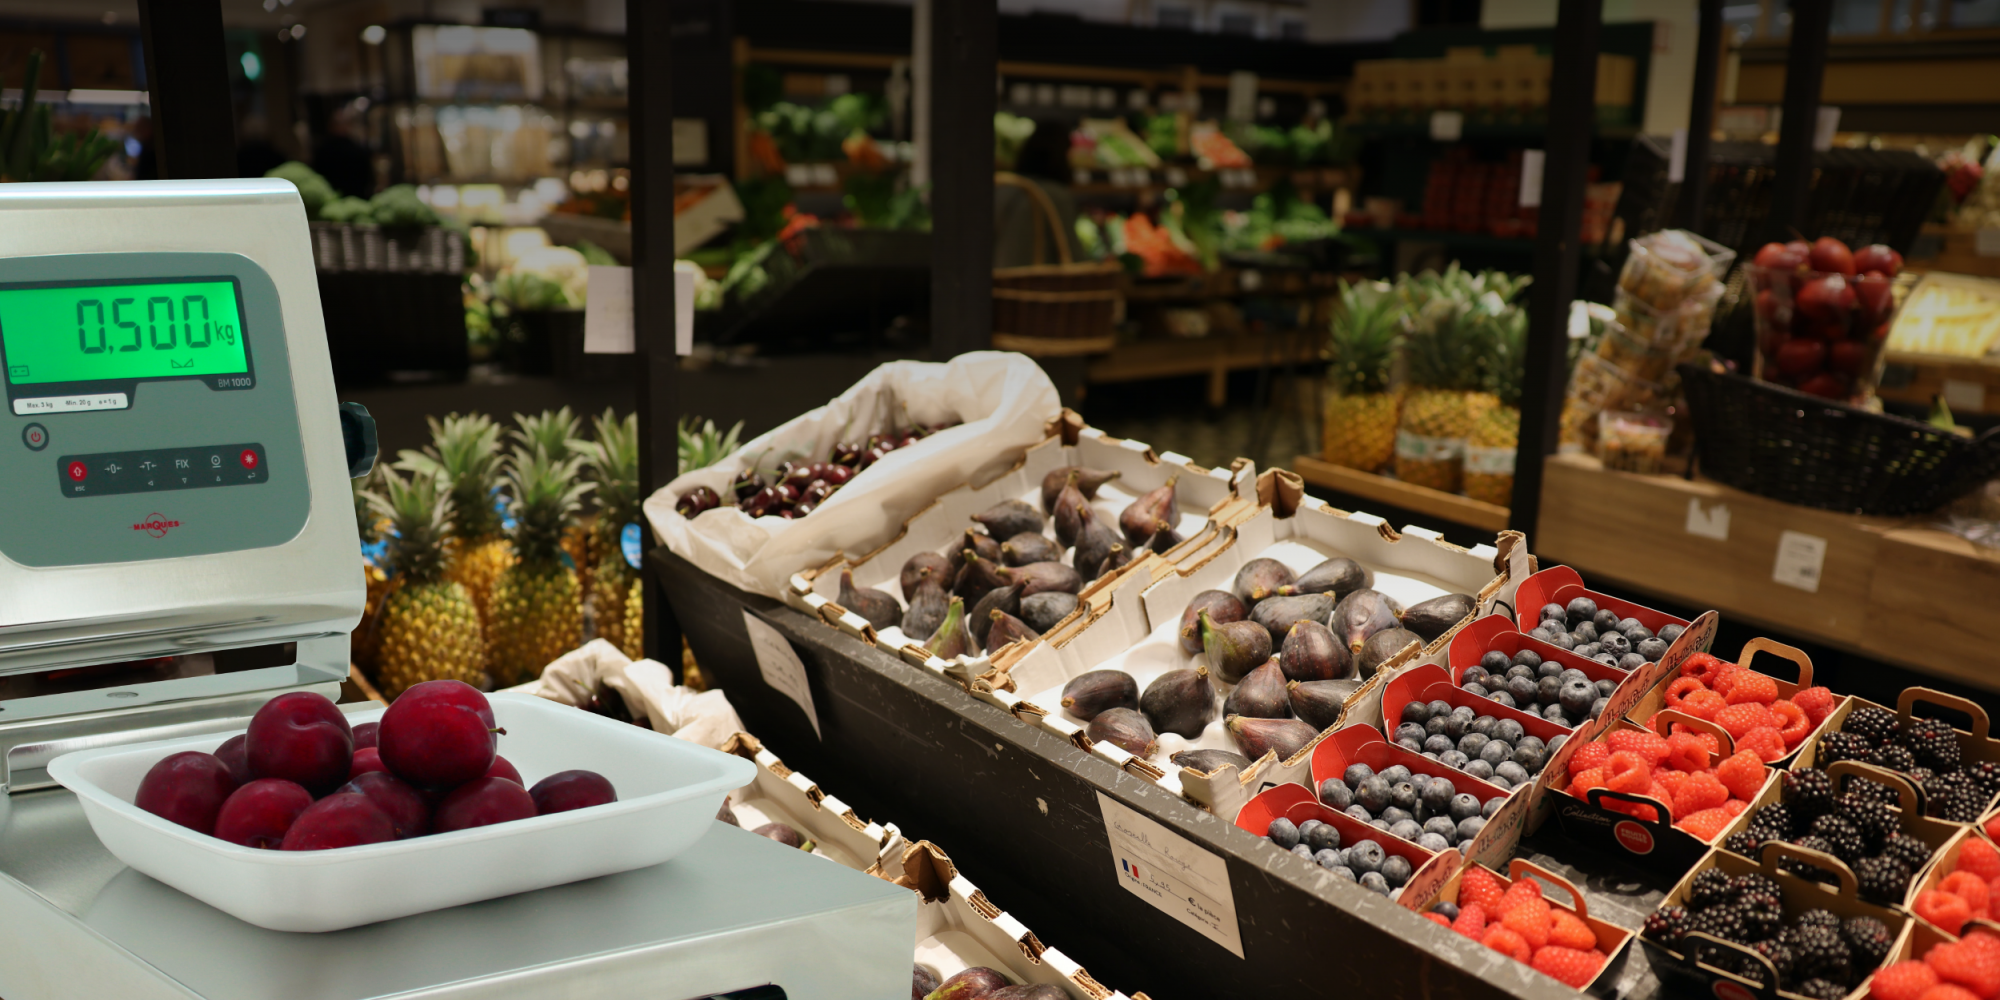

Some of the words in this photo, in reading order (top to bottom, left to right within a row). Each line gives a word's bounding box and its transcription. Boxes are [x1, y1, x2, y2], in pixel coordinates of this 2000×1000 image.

[76, 295, 211, 355] 0,500
[214, 320, 235, 346] kg
[217, 378, 230, 388] BM
[231, 377, 252, 387] 1000
[45, 401, 53, 409] kg
[175, 458, 190, 469] FIX
[133, 519, 180, 534] MARQUES
[1562, 806, 1612, 823] Collection
[1620, 828, 1648, 841] FRUITS
[1142, 882, 1163, 898] FRANCE
[1187, 896, 1196, 907] €
